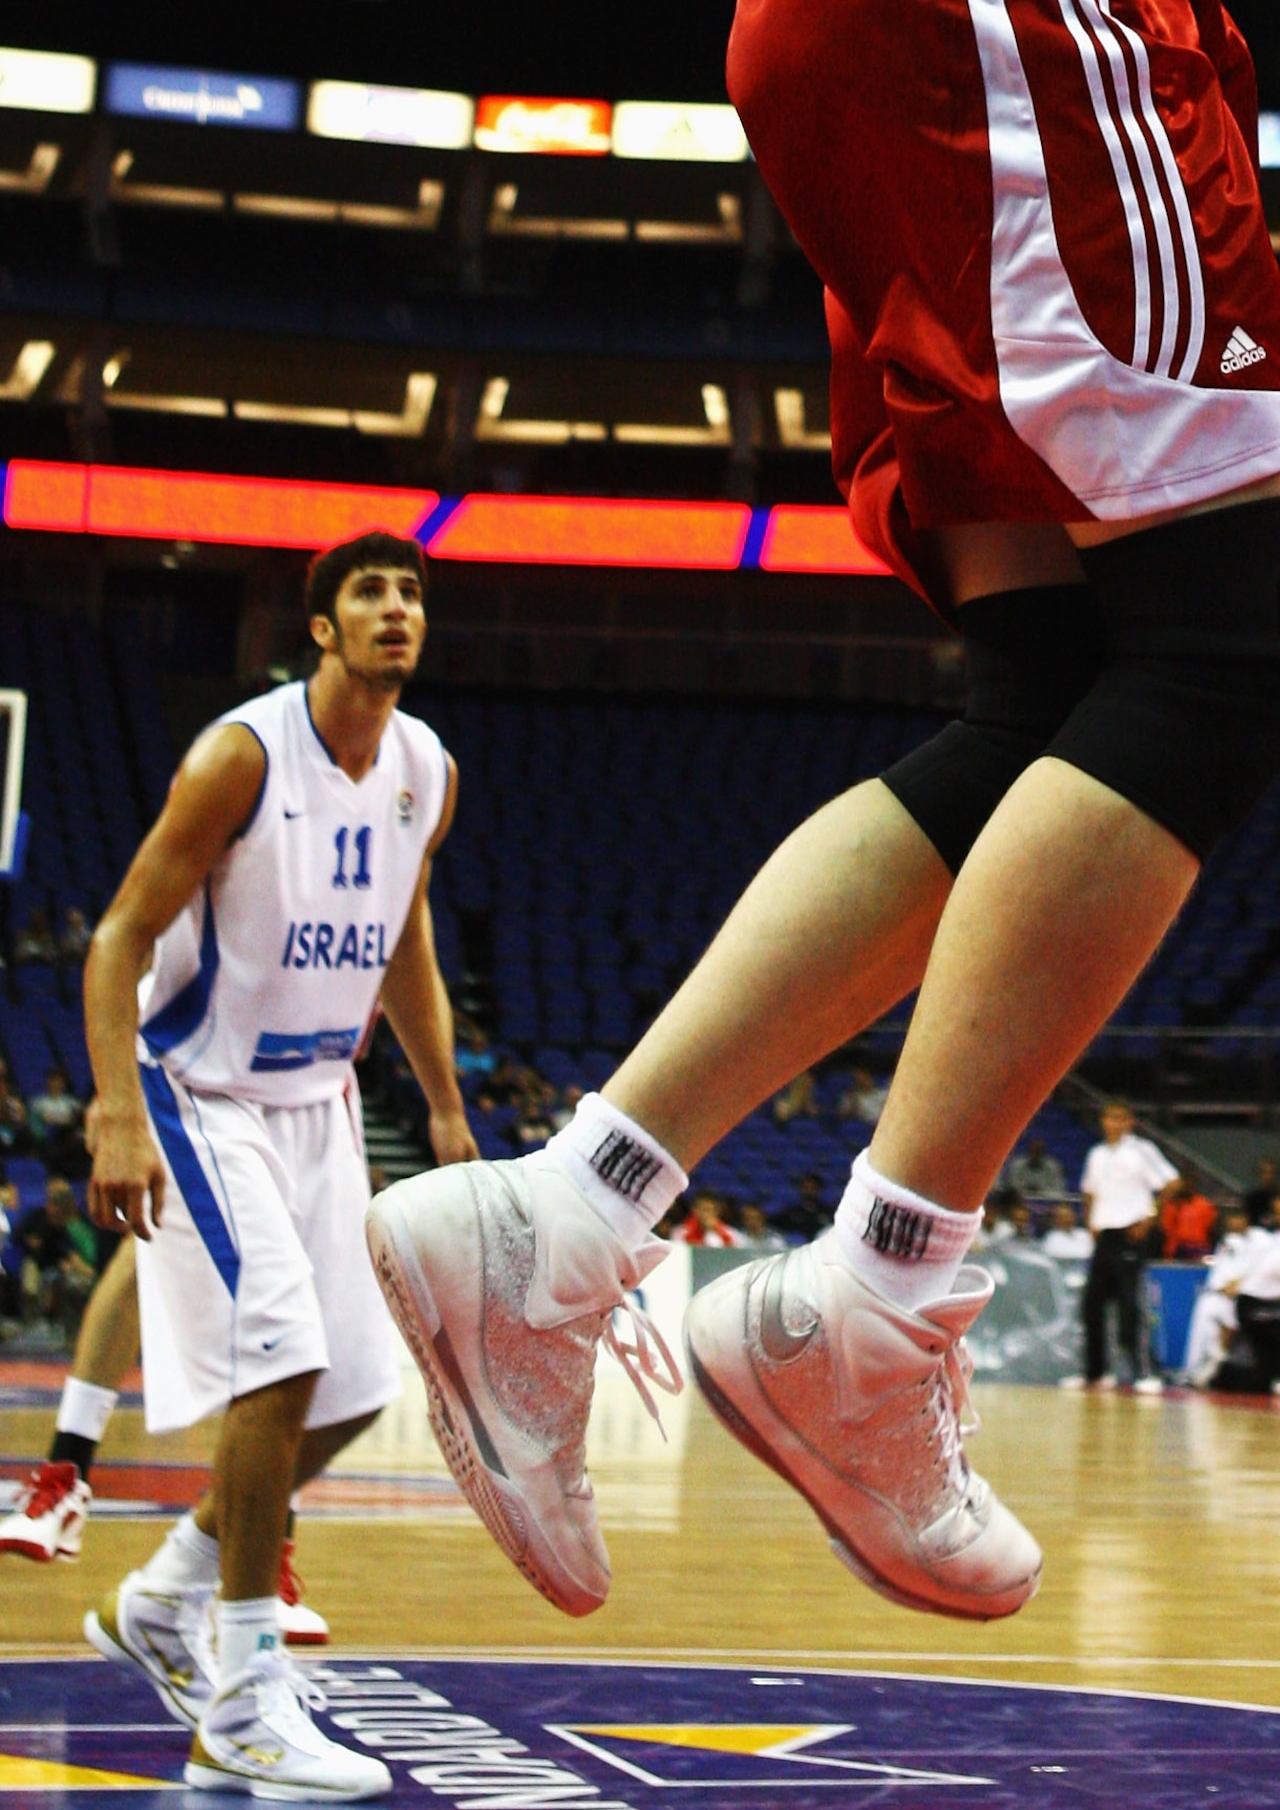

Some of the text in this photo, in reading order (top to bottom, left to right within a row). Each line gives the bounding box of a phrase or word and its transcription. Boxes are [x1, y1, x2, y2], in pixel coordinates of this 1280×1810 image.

[1220, 346, 1267, 374] adidas
[332, 825, 372, 890] 11
[282, 921, 389, 969] ISRAEL
